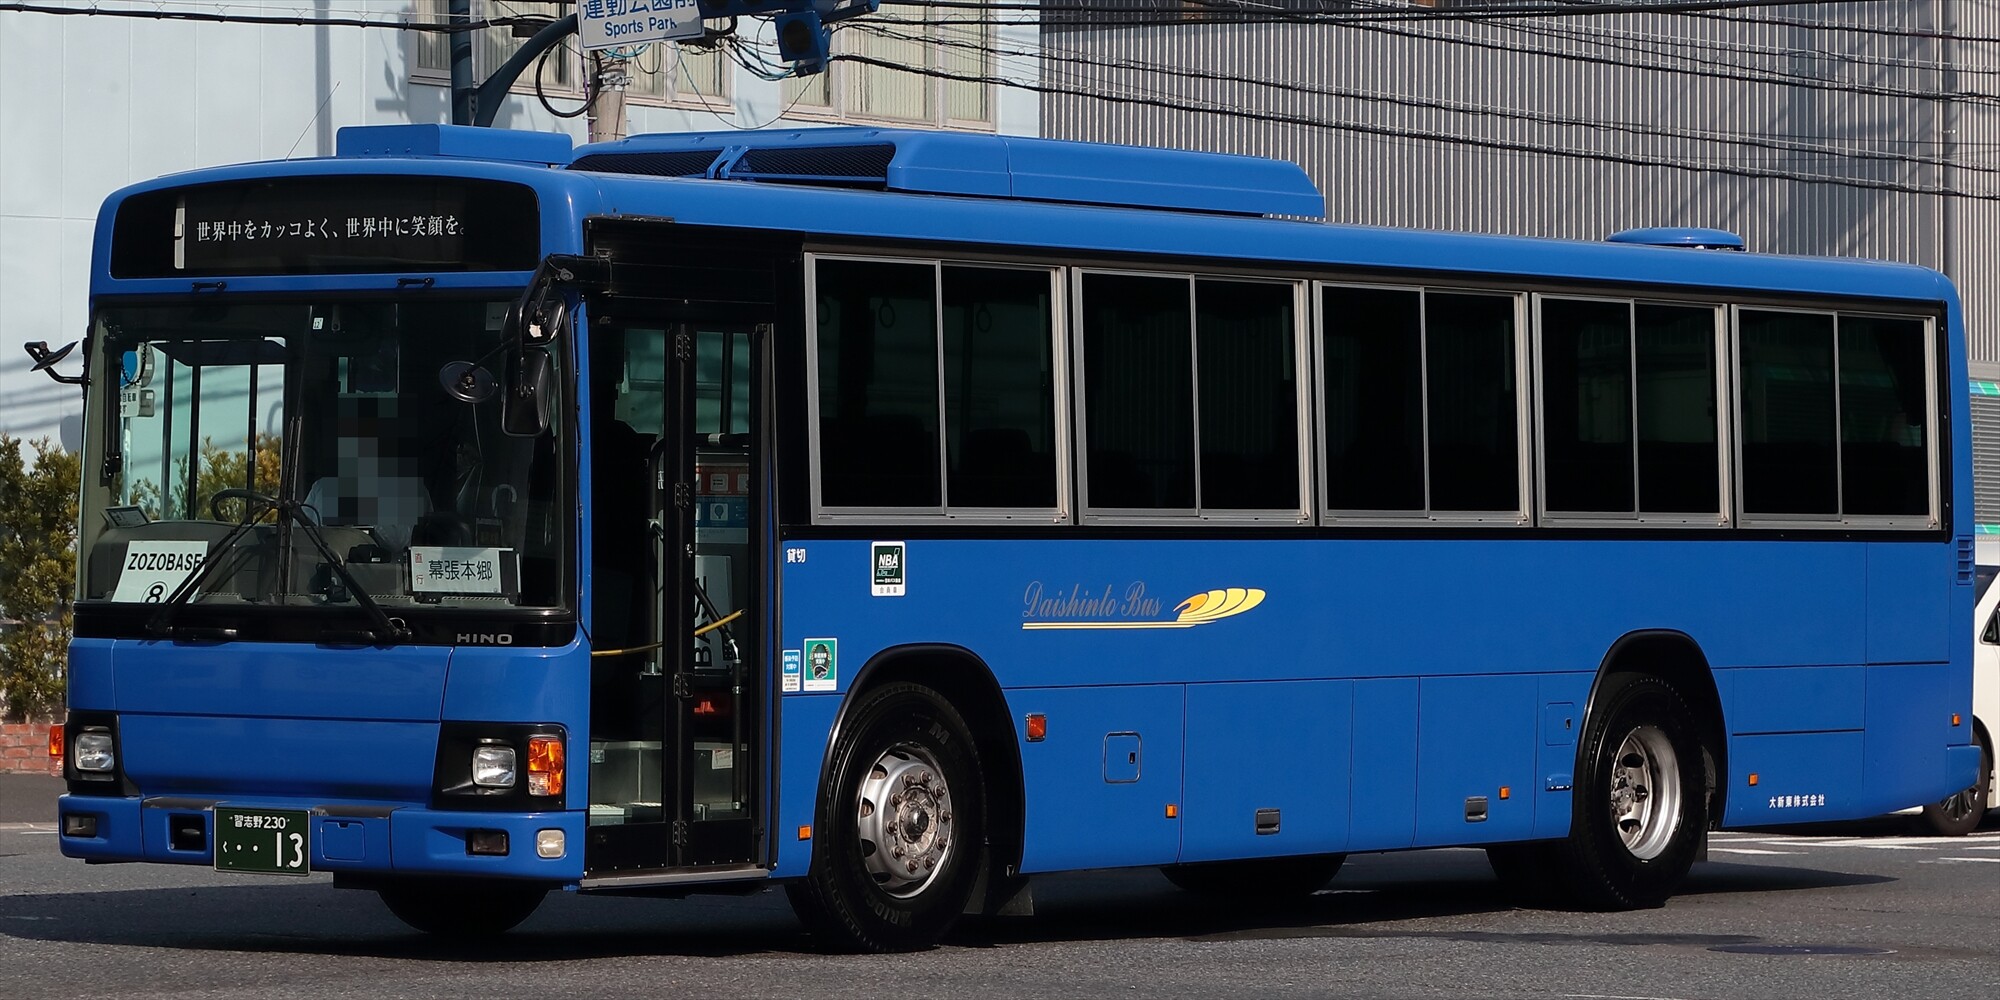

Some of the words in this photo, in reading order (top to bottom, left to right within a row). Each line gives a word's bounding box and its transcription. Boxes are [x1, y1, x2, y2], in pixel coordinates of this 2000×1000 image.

[604, 21, 643, 38] Sports
[649, 17, 677, 31] Park
[128, 553, 202, 570] ZOZOBASE
[787, 549, 806, 563] 貸切
[878, 554, 898, 566] NBA
[428, 560, 493, 580] 幕張本郷
[1022, 580, 1117, 617] Daishinto
[1121, 580, 1165, 617] Bus
[456, 633, 513, 645] HINO
[1769, 794, 1825, 808] 大新東株式会社
